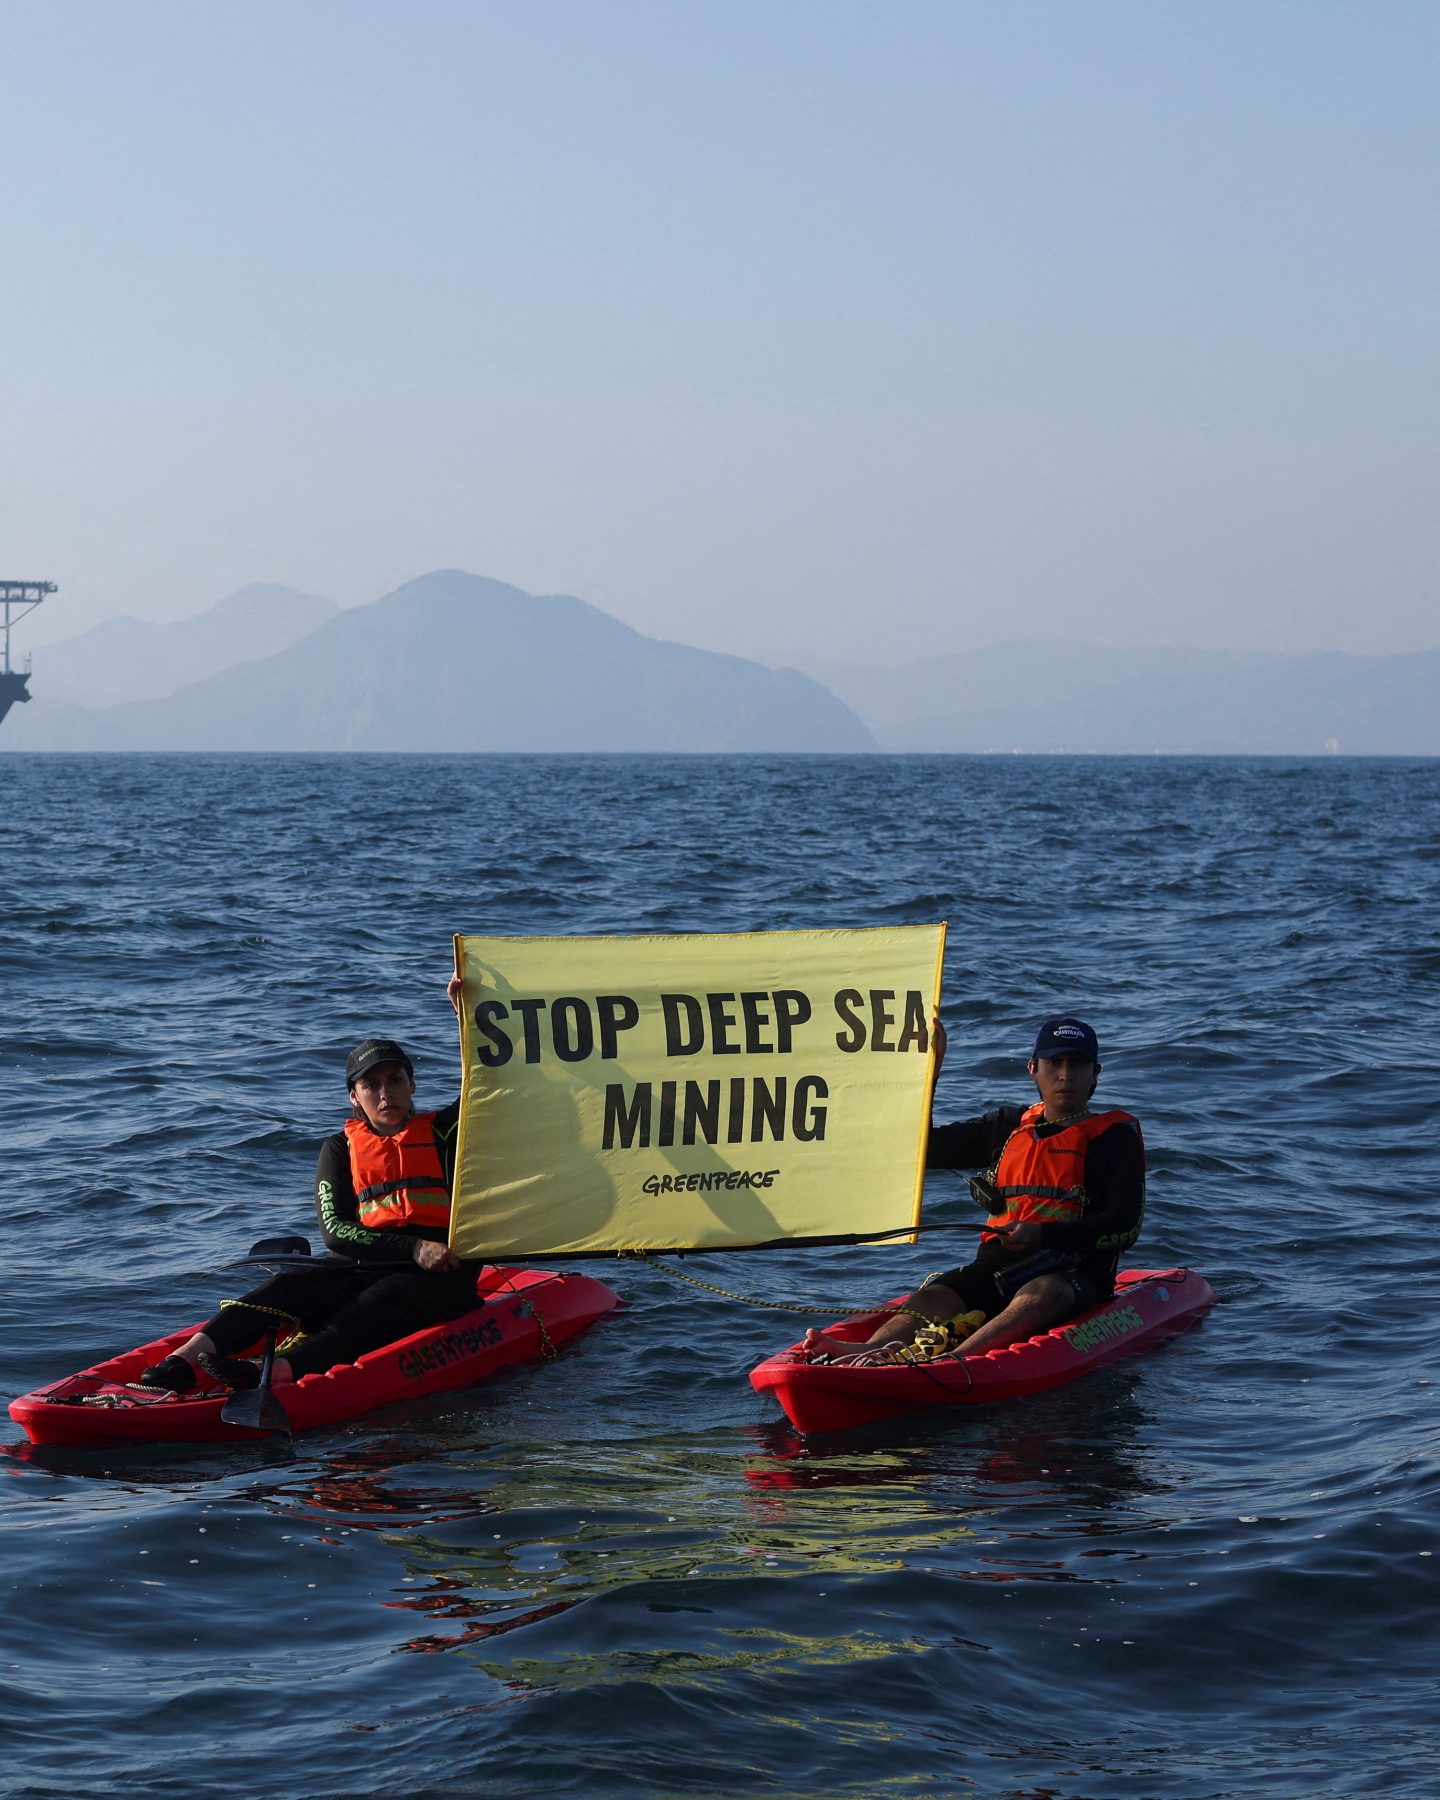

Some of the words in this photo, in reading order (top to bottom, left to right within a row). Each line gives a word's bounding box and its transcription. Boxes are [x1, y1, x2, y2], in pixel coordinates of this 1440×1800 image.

[474, 995, 639, 1067] STOP
[662, 990, 811, 1056] DEEP
[834, 989, 928, 1053] SEA
[602, 1075, 829, 1149] MINING
[318, 1180, 380, 1245] GREENPEACE
[642, 1169, 780, 1197] GREENPEACE
[398, 1318, 503, 1381] GREENPEACE
[1063, 1304, 1144, 1353] GREENPEACE
